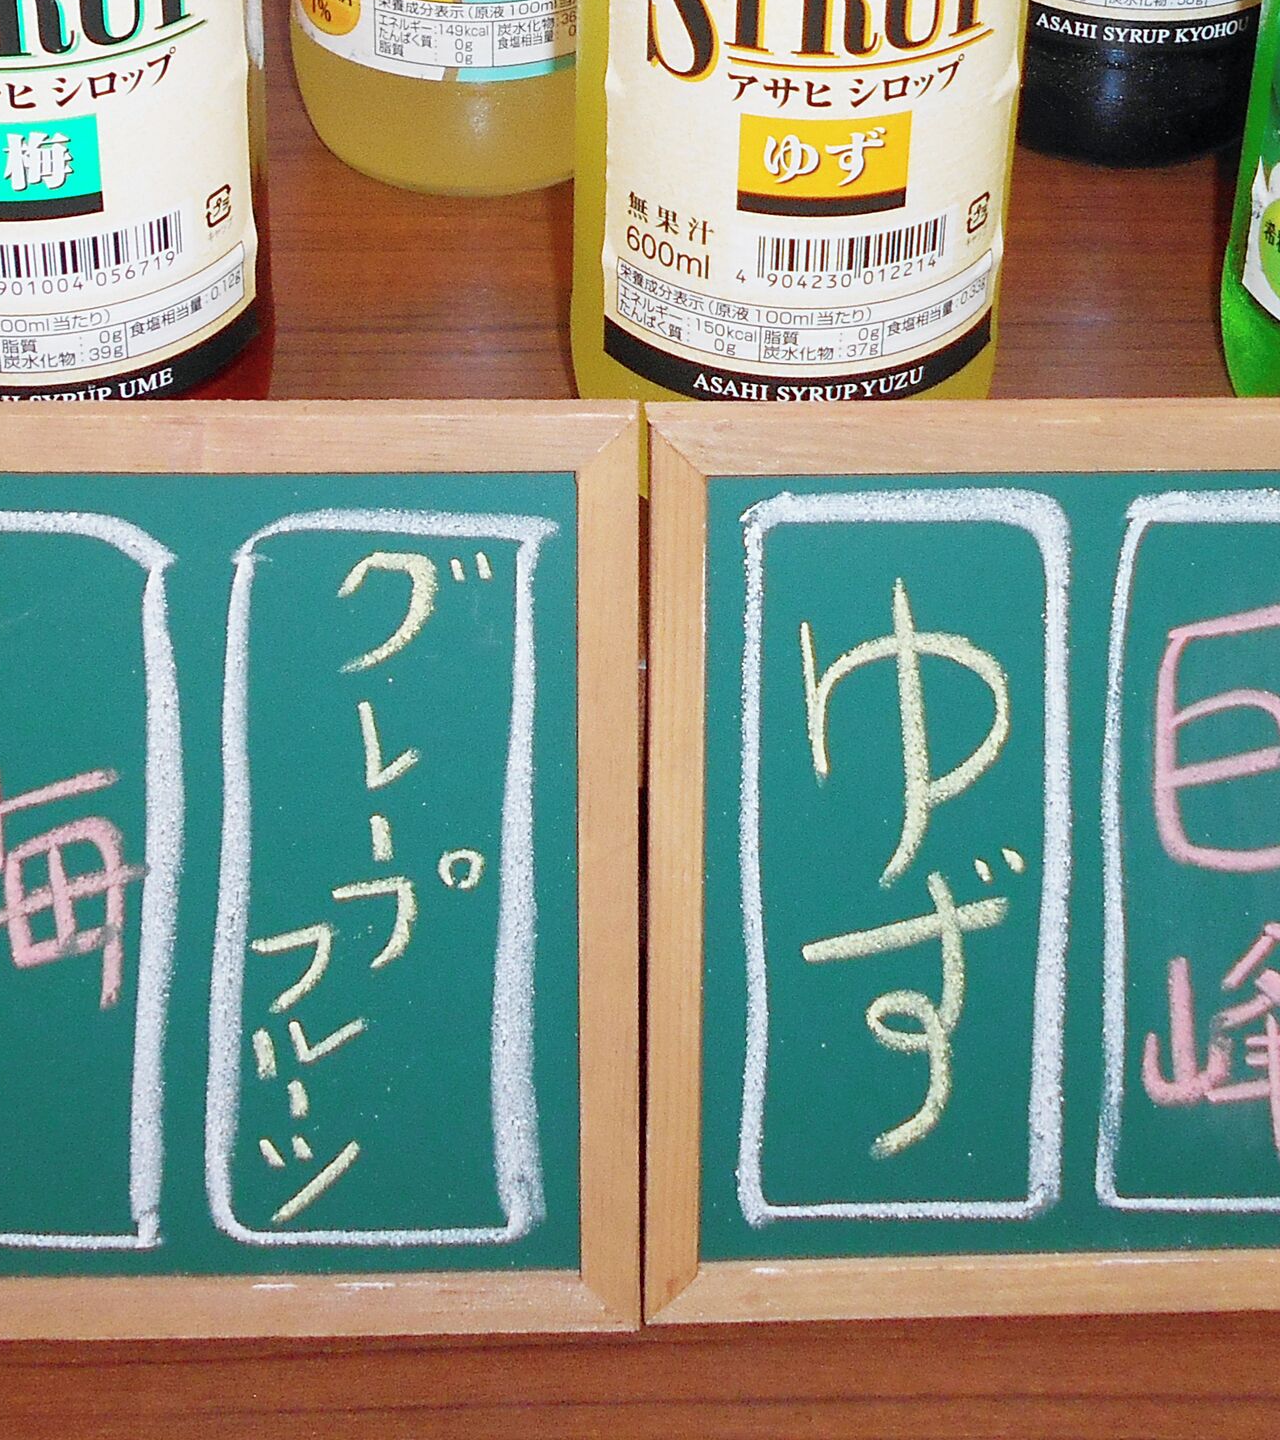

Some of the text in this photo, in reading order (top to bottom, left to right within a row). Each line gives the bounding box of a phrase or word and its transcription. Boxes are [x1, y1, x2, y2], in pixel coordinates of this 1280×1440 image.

[1036, 13, 1097, 40] ASAHI
[1104, 26, 1170, 44] SYRUP
[52, 46, 178, 107] シロップ
[728, 53, 966, 108] アサヒ シロップ
[4, 132, 74, 192] 梅
[763, 127, 888, 187] ゆず
[628, 191, 715, 245] 無果汁
[96, 250, 176, 287] 056719
[626, 225, 709, 280] 600ml
[767, 273, 852, 289] 904230
[863, 255, 937, 285] 012214
[119, 368, 174, 399] UME
[692, 365, 924, 401] ASAHI SYRUP YUZU
[800, 577, 1027, 1160] ゆず
